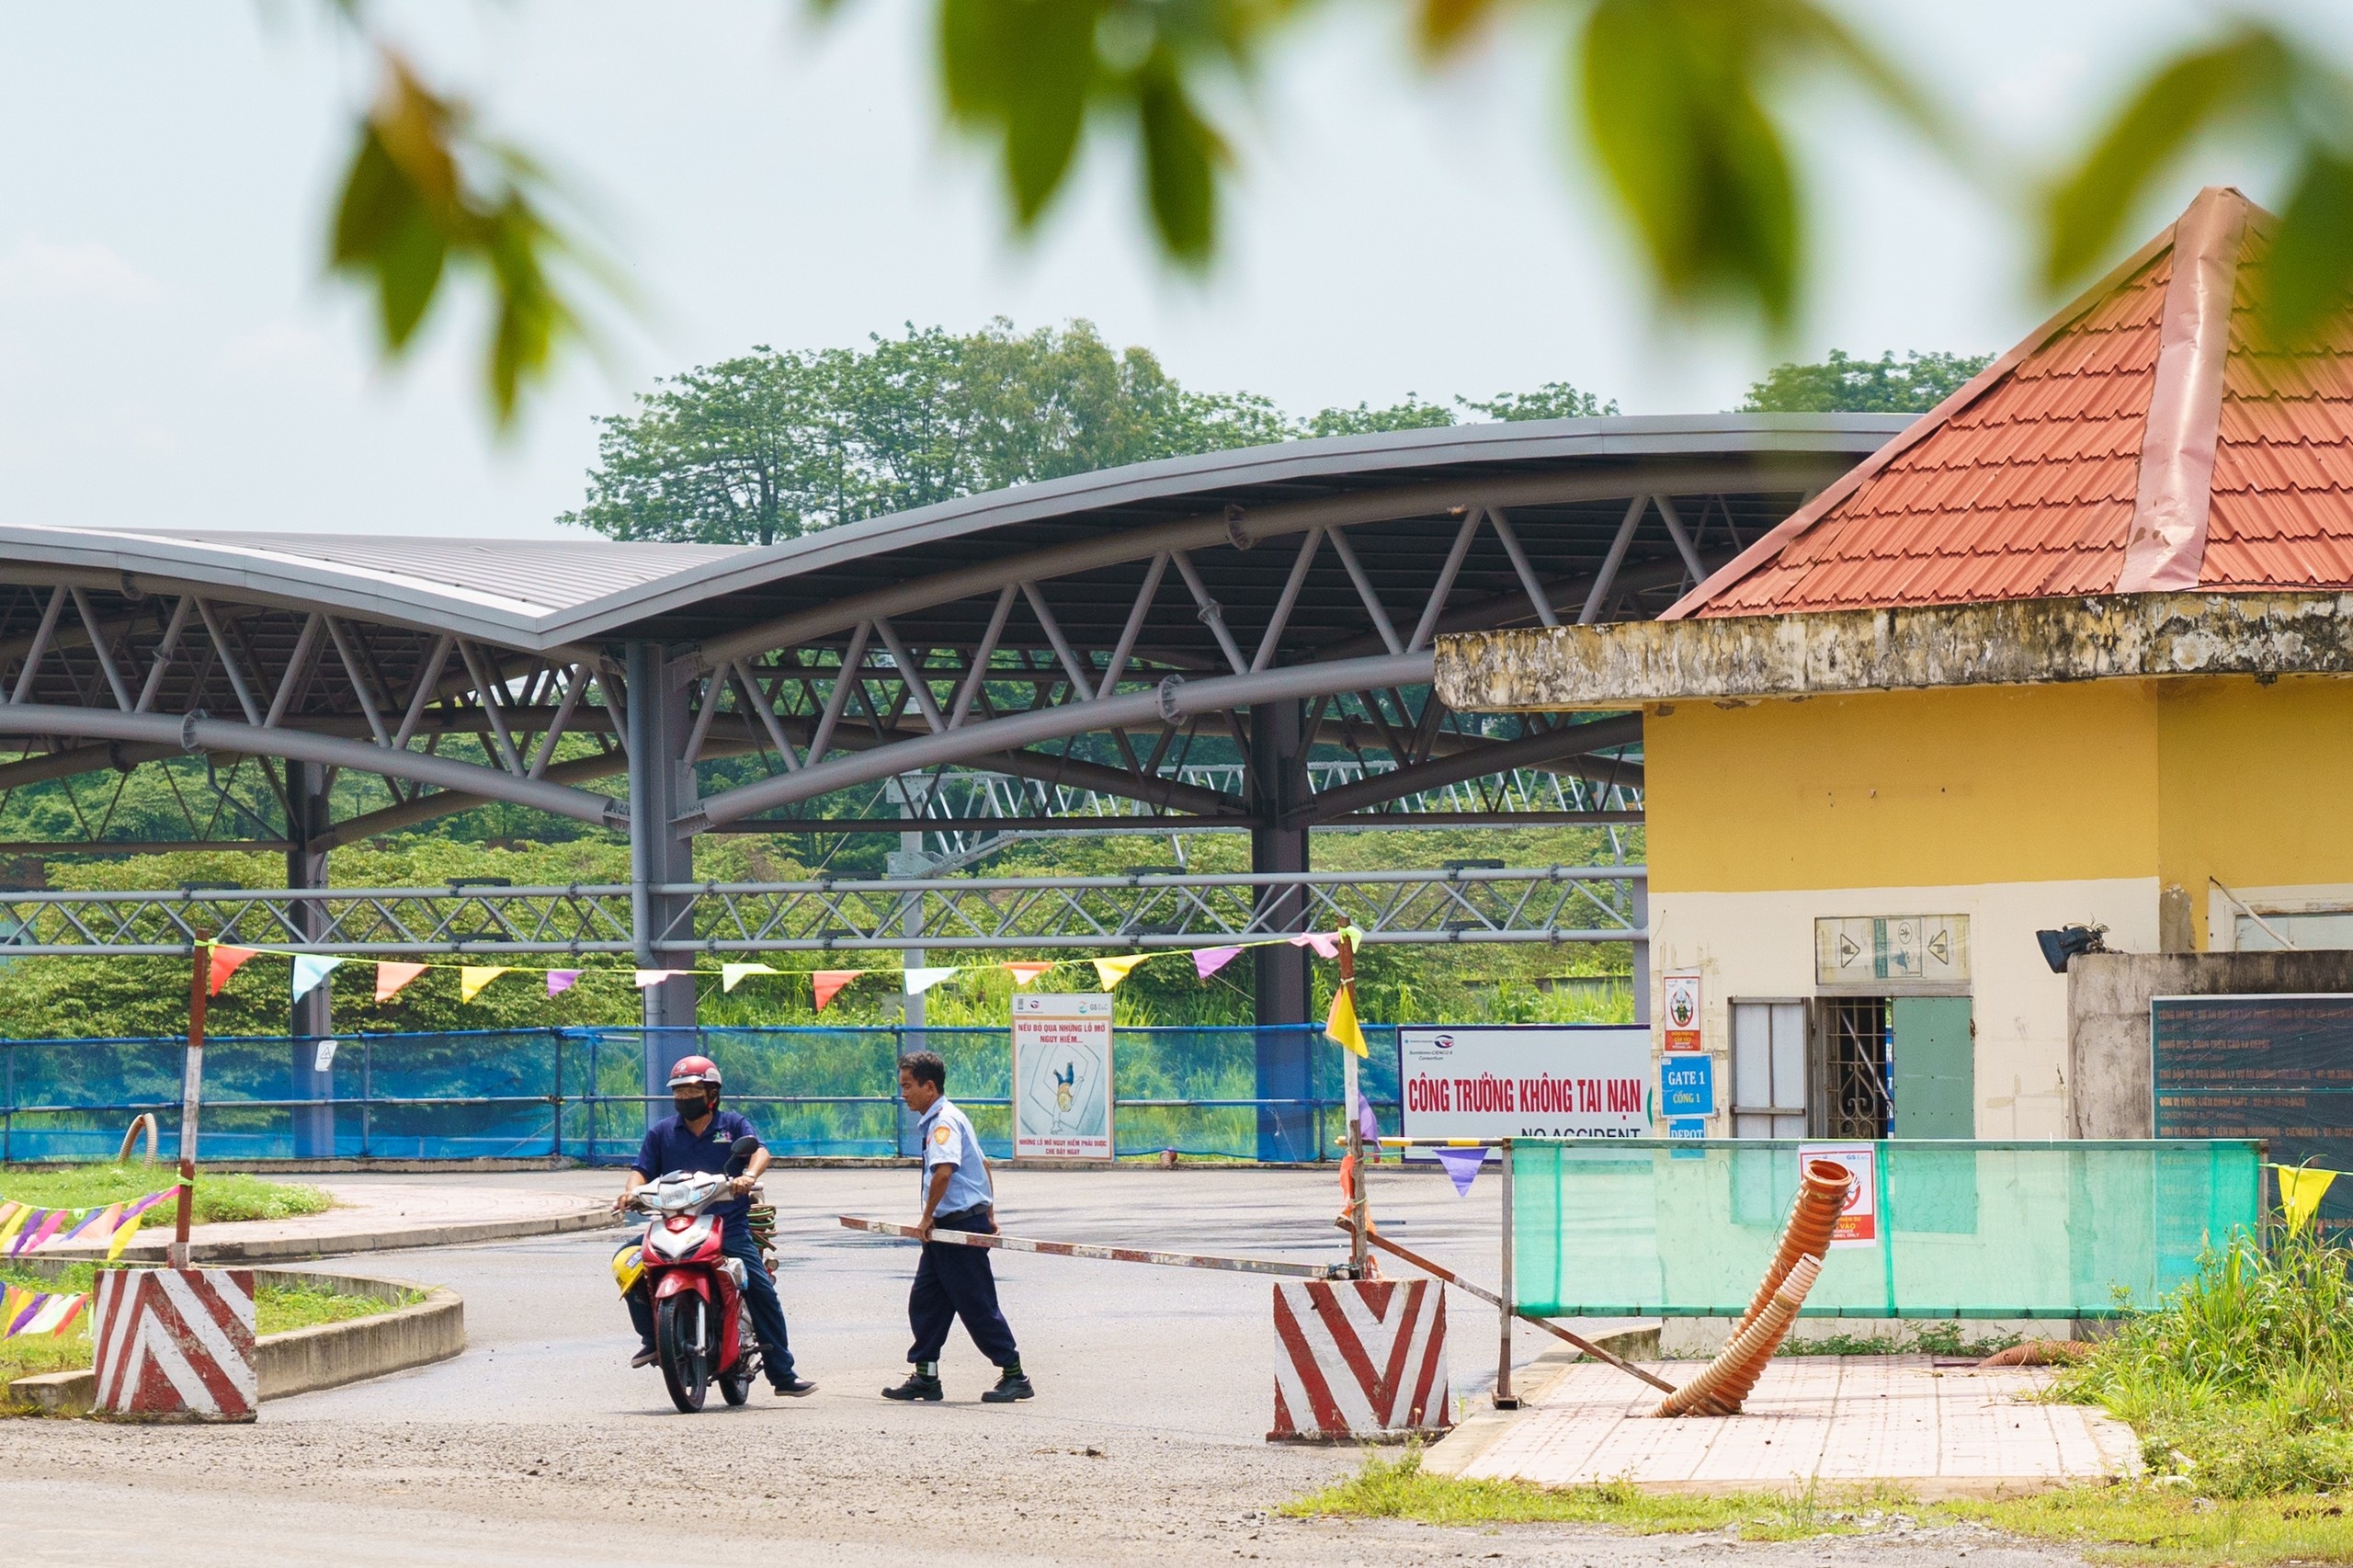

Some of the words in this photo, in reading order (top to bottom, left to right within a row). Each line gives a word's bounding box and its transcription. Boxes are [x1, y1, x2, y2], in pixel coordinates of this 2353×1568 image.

[1044, 1024, 1057, 1032] QUA
[1040, 1035, 1057, 1043] NGUY
[1668, 1072, 1696, 1085] GATE
[1699, 1071, 1705, 1085] 1
[1408, 1072, 1449, 1112] CÔNG
[1454, 1072, 1514, 1112] TRƯỜNG
[1519, 1072, 1573, 1112] KHÔNG
[1577, 1079, 1601, 1112] TAI
[1608, 1079, 1641, 1120] NẠN
[1696, 1093, 1700, 1103] 1
[1521, 1128, 1546, 1137] NO
[1553, 1128, 1641, 1137] ACCIDENT
[1670, 1130, 1704, 1139] DEPOT
